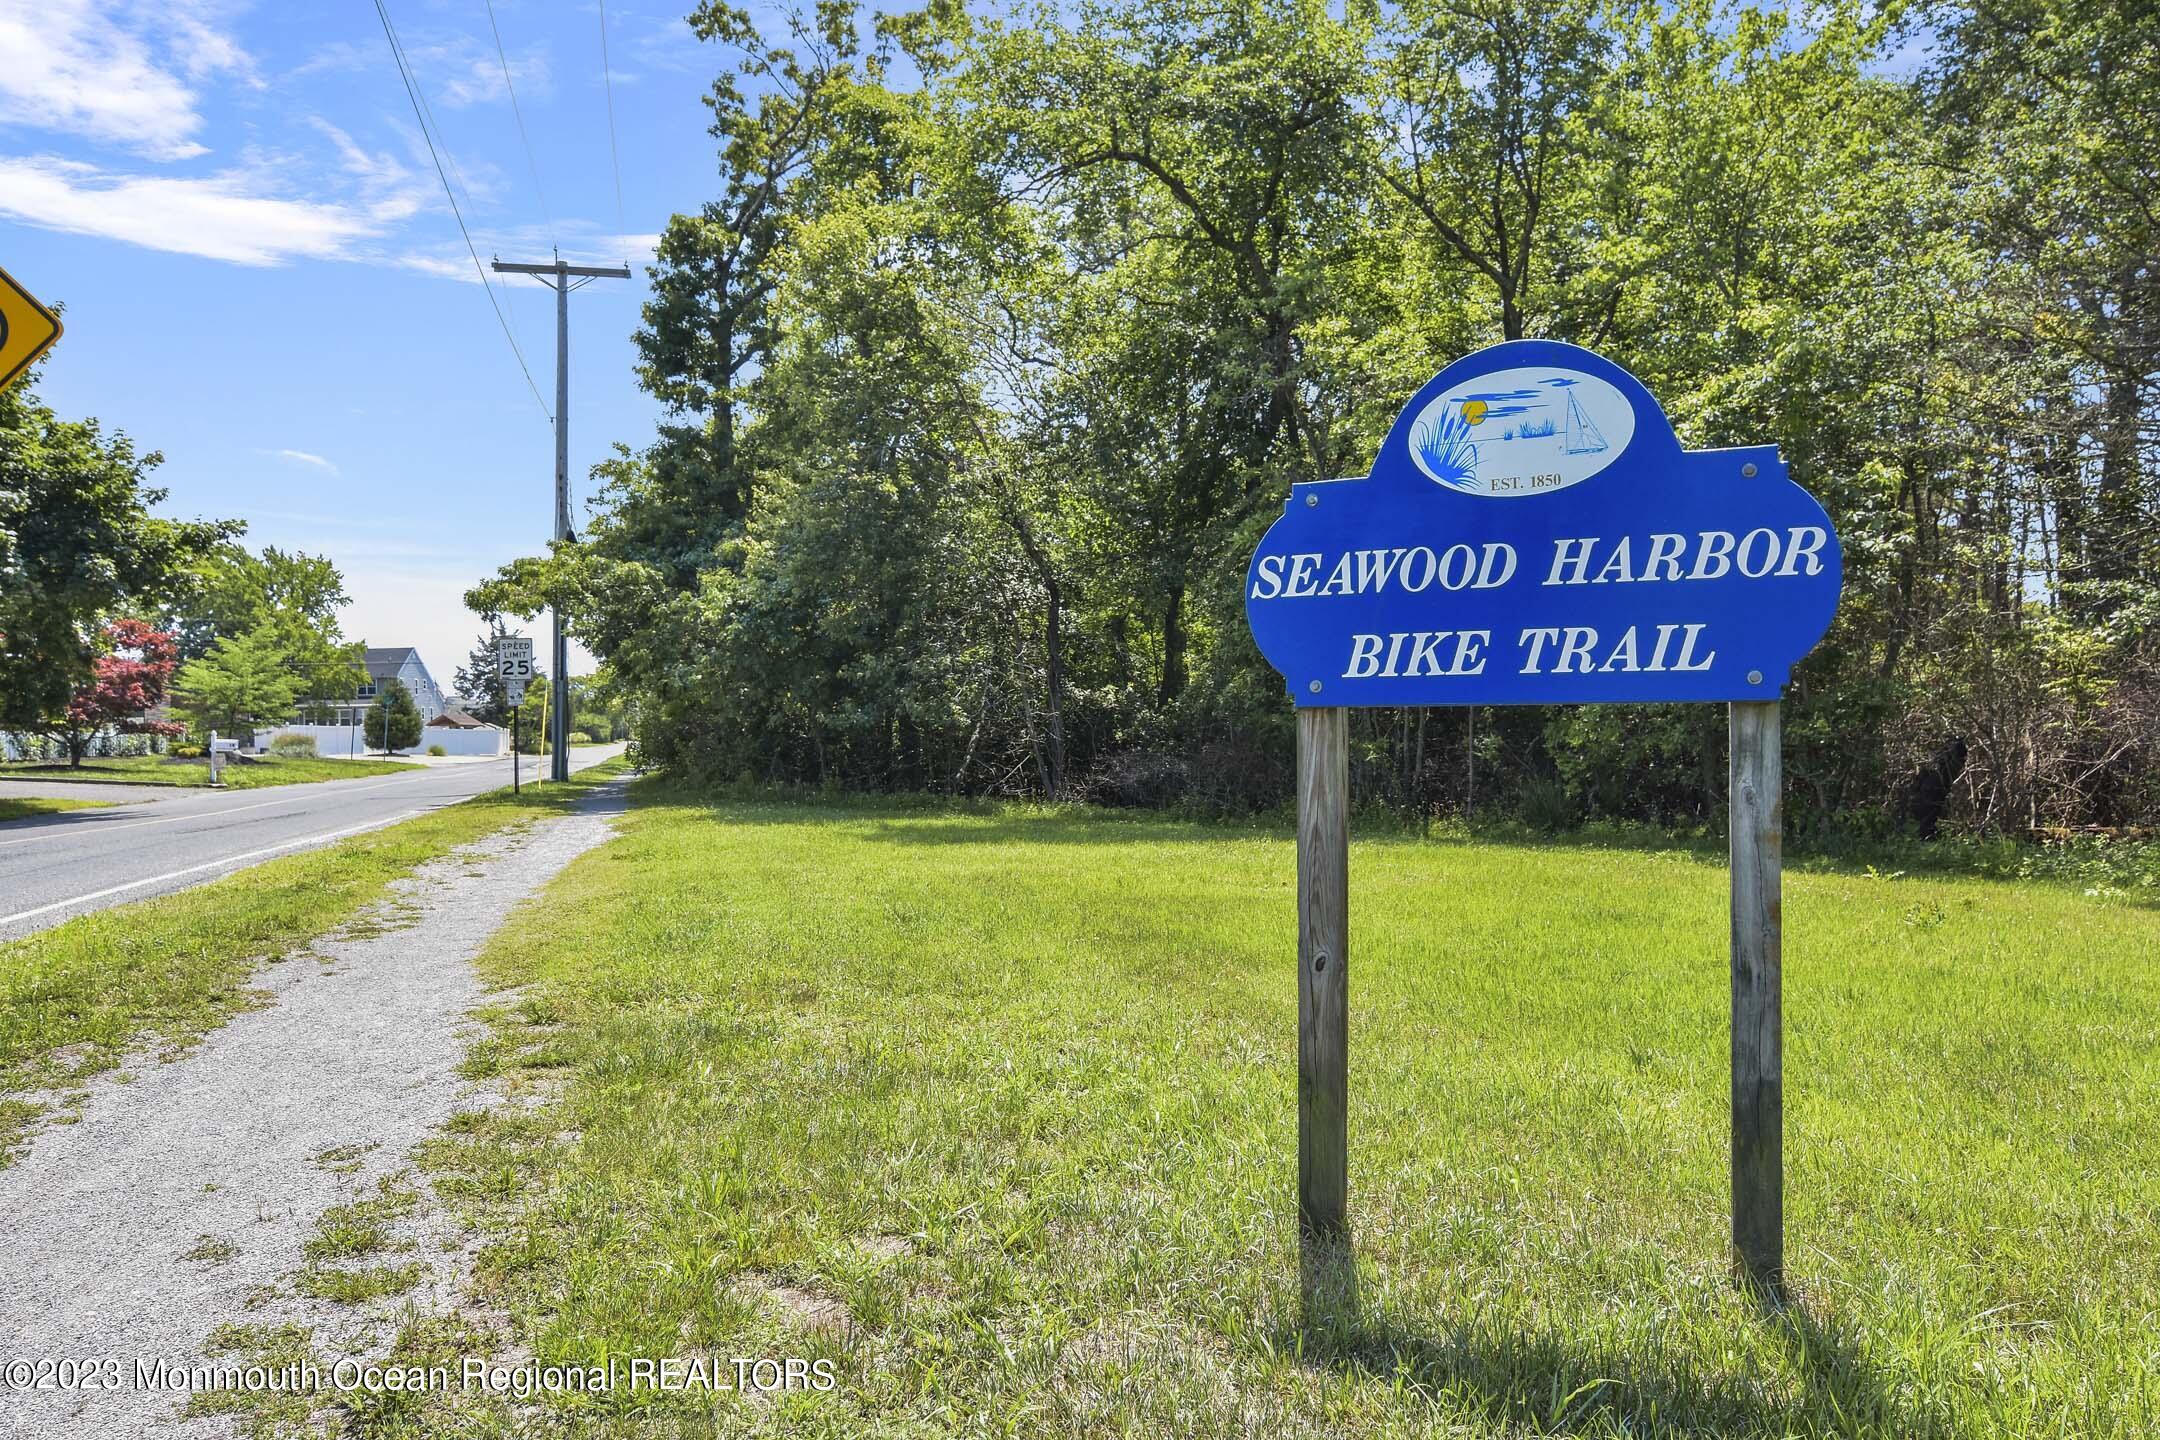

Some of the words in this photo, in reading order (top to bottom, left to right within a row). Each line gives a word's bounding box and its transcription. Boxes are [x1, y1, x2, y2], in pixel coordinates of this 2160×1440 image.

[1491, 477, 1523, 491] EST.
[1531, 473, 1561, 488] 1850
[1251, 543, 1517, 600] SEAWOOD
[1542, 526, 1827, 586] HARBOR
[502, 642, 529, 650] SPEED
[1342, 631, 1490, 678] BIKE
[1518, 623, 1716, 675] TRAIL
[502, 660, 529, 675] 25
